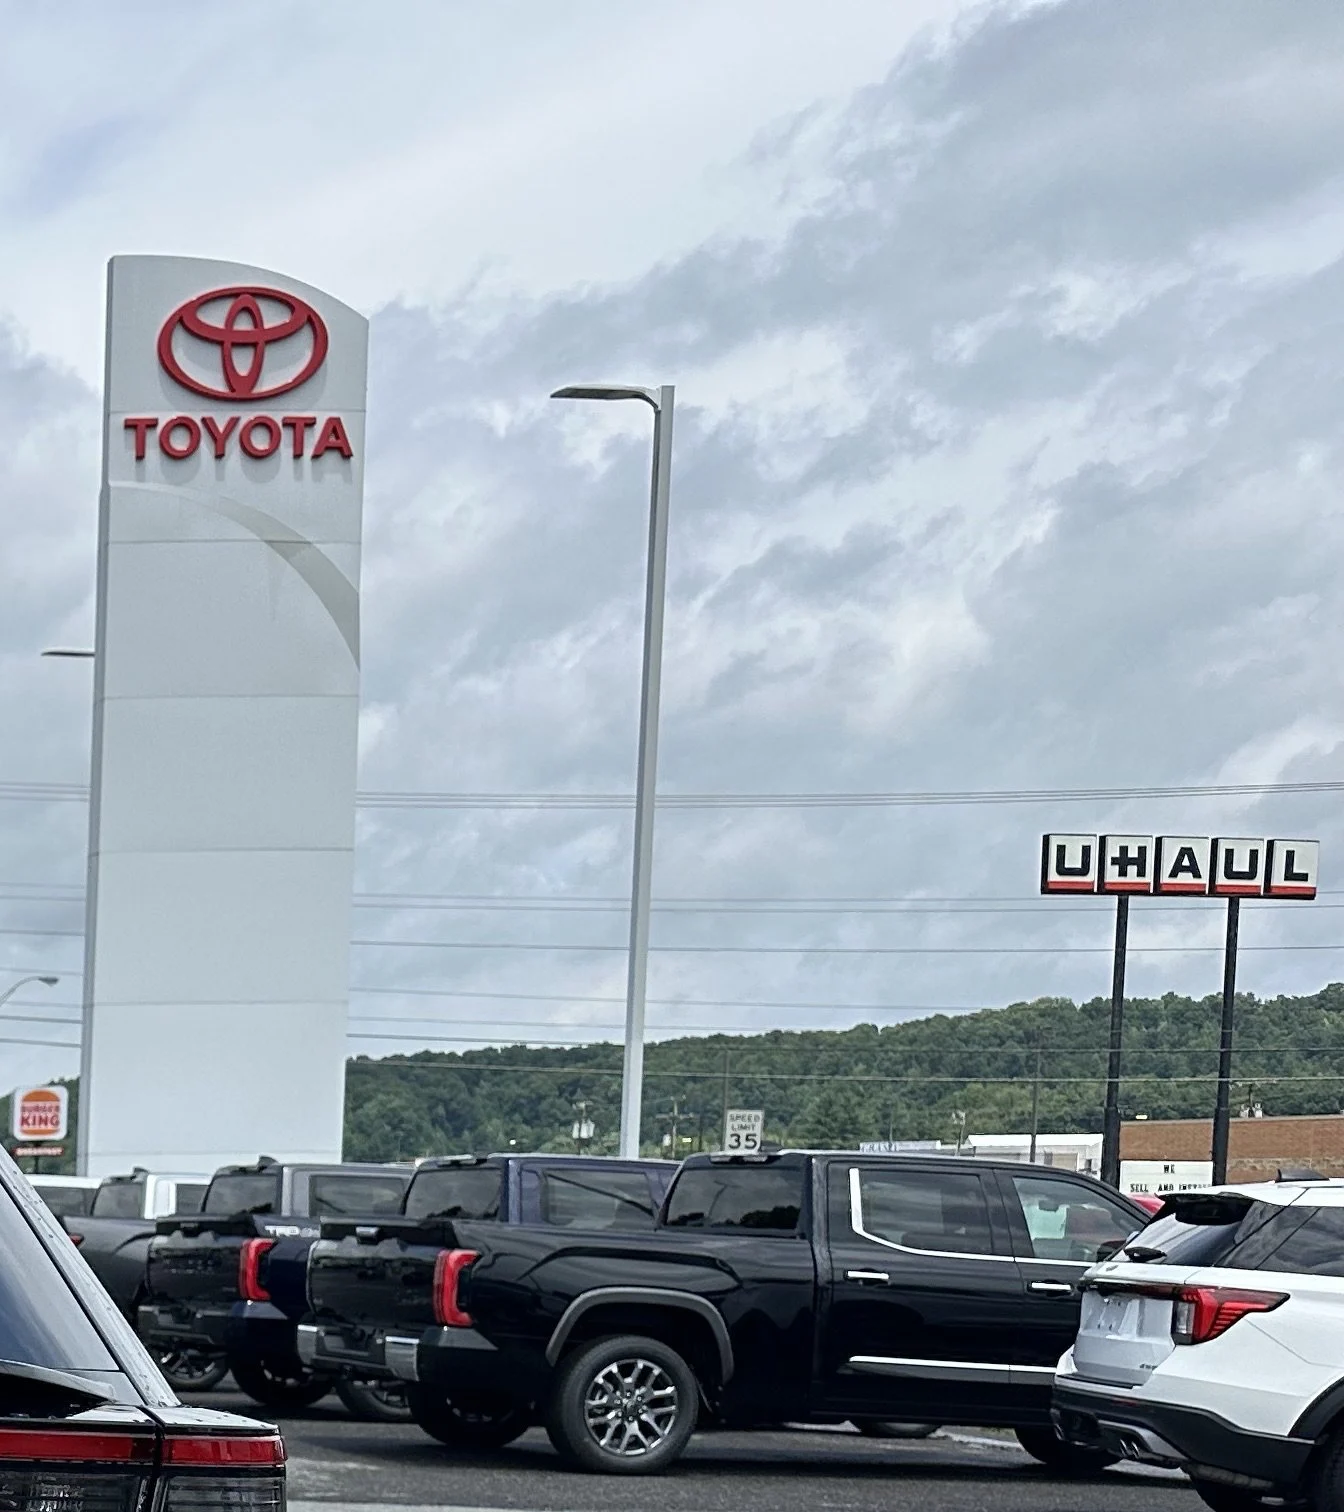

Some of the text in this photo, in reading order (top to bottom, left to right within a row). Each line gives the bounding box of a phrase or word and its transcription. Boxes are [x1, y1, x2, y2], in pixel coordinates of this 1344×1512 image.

[123, 415, 354, 461] TOYOTA
[20, 1115, 60, 1126] KING
[729, 1113, 761, 1122] SPEED
[728, 1133, 757, 1149] 35
[1163, 1164, 1175, 1174] WE
[1130, 1183, 1149, 1192] SELL
[1158, 1183, 1174, 1192] AND
